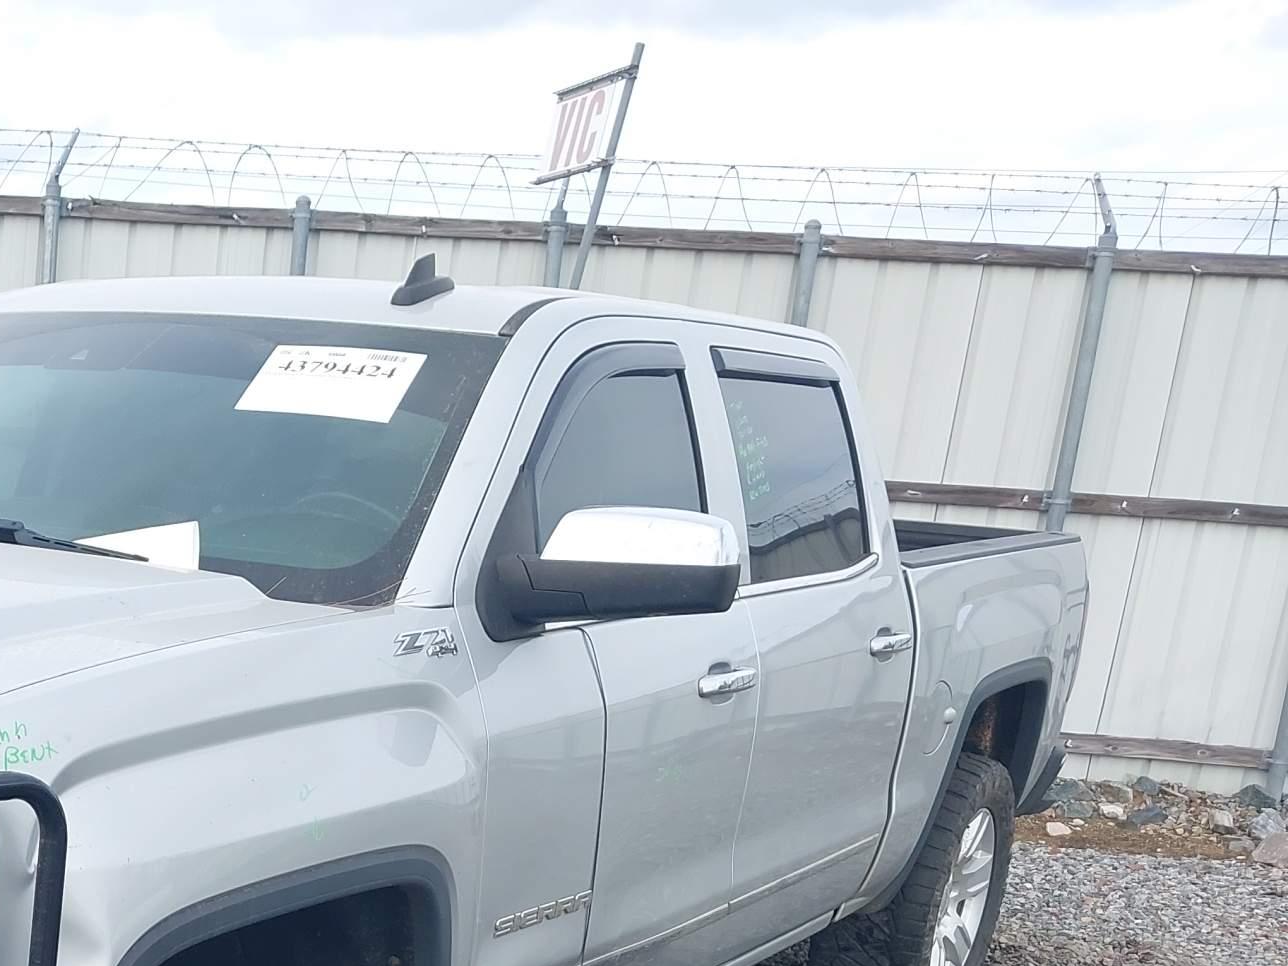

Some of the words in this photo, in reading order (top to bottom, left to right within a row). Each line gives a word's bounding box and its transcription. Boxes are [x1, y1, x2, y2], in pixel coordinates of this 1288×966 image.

[548, 90, 606, 171] VIC
[278, 359, 400, 379] 43794424
[493, 889, 593, 939] SIERRA
